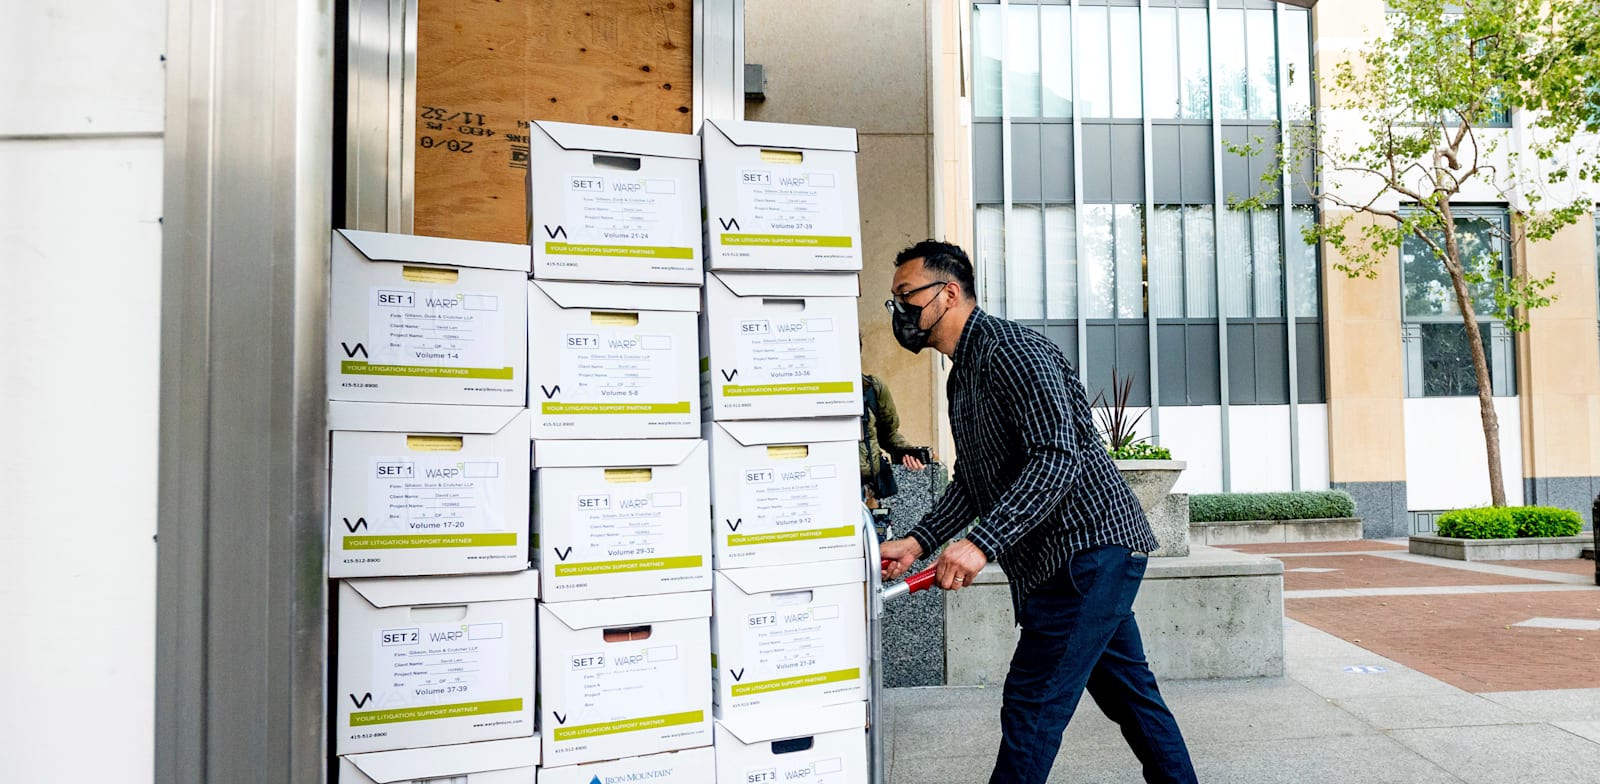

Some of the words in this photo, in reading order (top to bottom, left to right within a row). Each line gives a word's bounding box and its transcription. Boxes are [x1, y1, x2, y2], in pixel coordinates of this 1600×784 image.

[421, 105, 486, 126] 11/32
[743, 173, 762, 182] SET
[573, 180, 594, 189] SET
[379, 294, 403, 304] SET
[408, 295, 413, 304] 1
[742, 324, 760, 332] SET
[568, 338, 589, 346] SET
[592, 338, 597, 346] 1
[415, 351, 444, 359] Volume
[378, 466, 403, 475] SET
[407, 466, 412, 474] 1
[747, 473, 764, 481] SET
[579, 498, 600, 507] SET
[604, 498, 608, 506] 1
[750, 616, 767, 626] SET
[383, 633, 408, 643] SET
[411, 632, 417, 641] 2
[573, 657, 594, 667] SET
[598, 656, 604, 665] 2
[415, 688, 445, 696] Volume
[447, 685, 468, 693] 37-39
[377, 713, 416, 721] LITIGATION
[605, 776, 625, 784] IRON
[626, 769, 670, 782] MOUNTAIN
[748, 773, 766, 783] SET
[770, 772, 776, 780] 3
